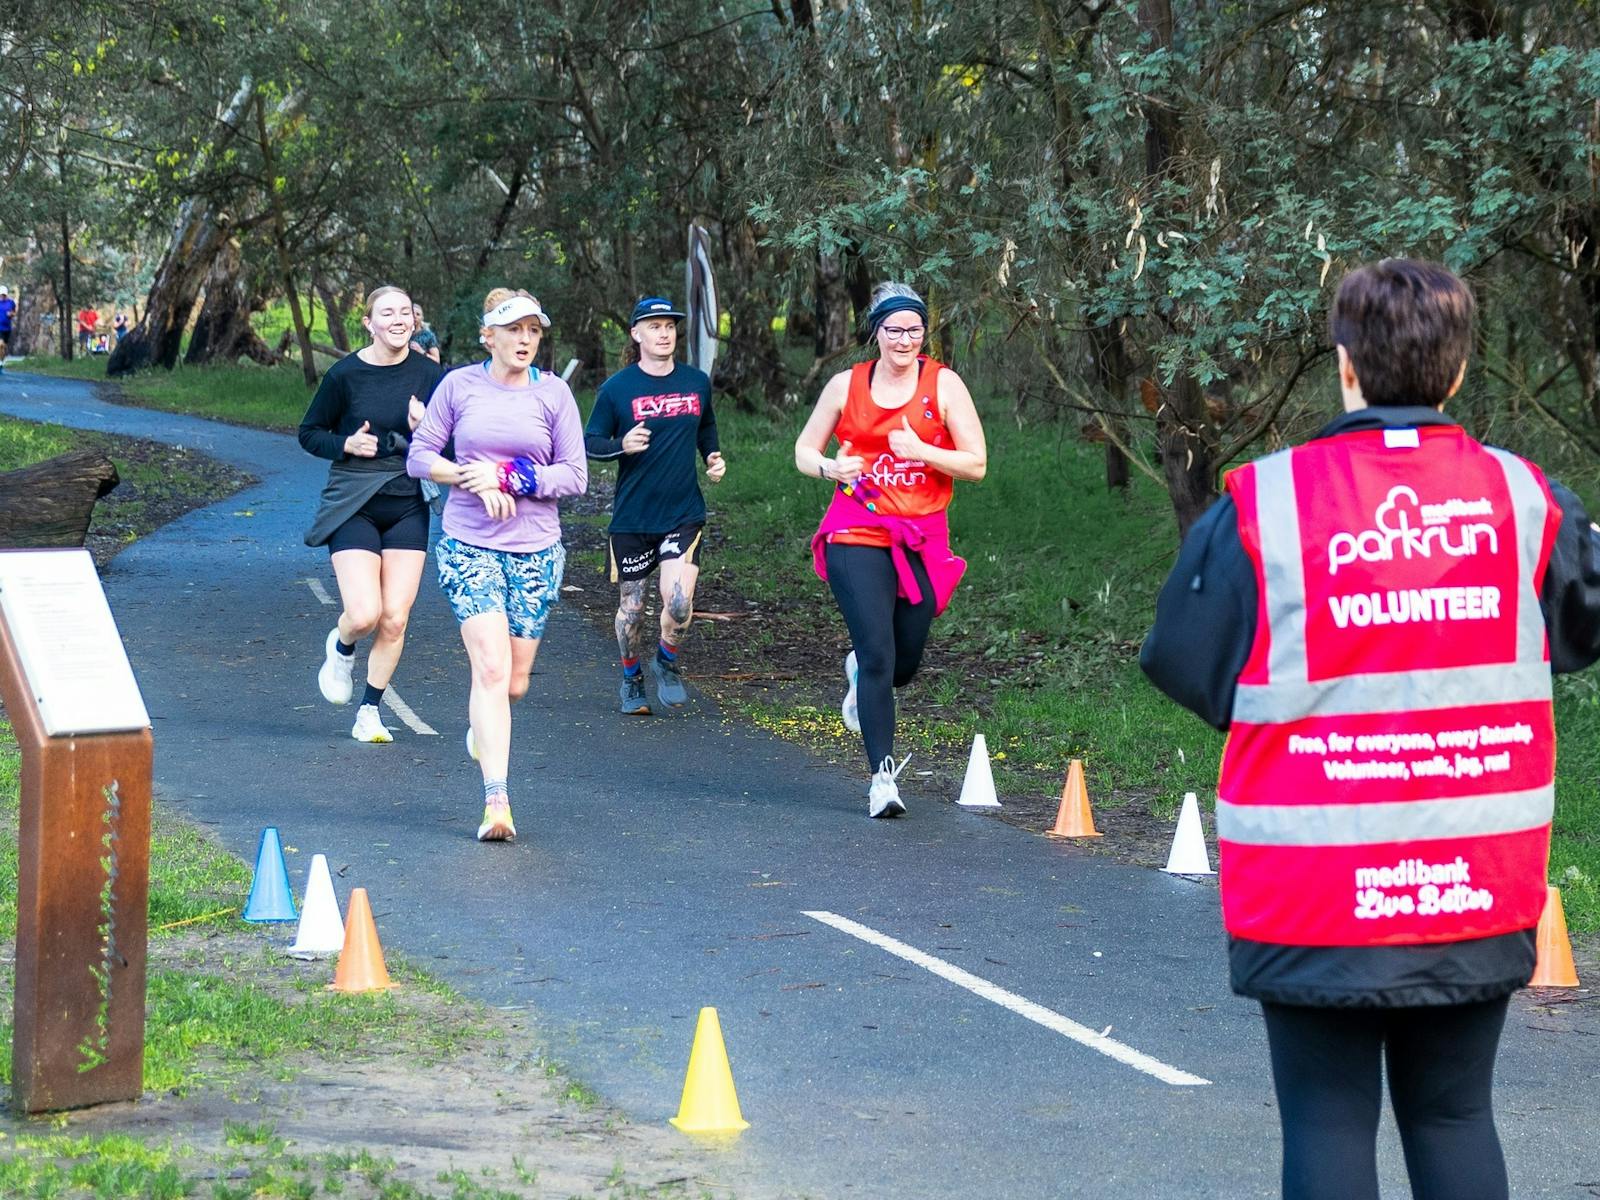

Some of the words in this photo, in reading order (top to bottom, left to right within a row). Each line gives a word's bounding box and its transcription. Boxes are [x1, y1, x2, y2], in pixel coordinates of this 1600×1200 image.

[1329, 506, 1498, 575] parkrun
[1328, 586, 1501, 629] VOLUNTEER
[1288, 734, 1327, 756] Free,
[1327, 732, 1354, 752] for
[1355, 733, 1436, 754] everyone,
[1436, 729, 1479, 750] every
[1323, 759, 1410, 781] Volunteer,
[1410, 755, 1454, 777] walk,
[1454, 752, 1484, 778] jog,
[1355, 856, 1471, 888] medibank
